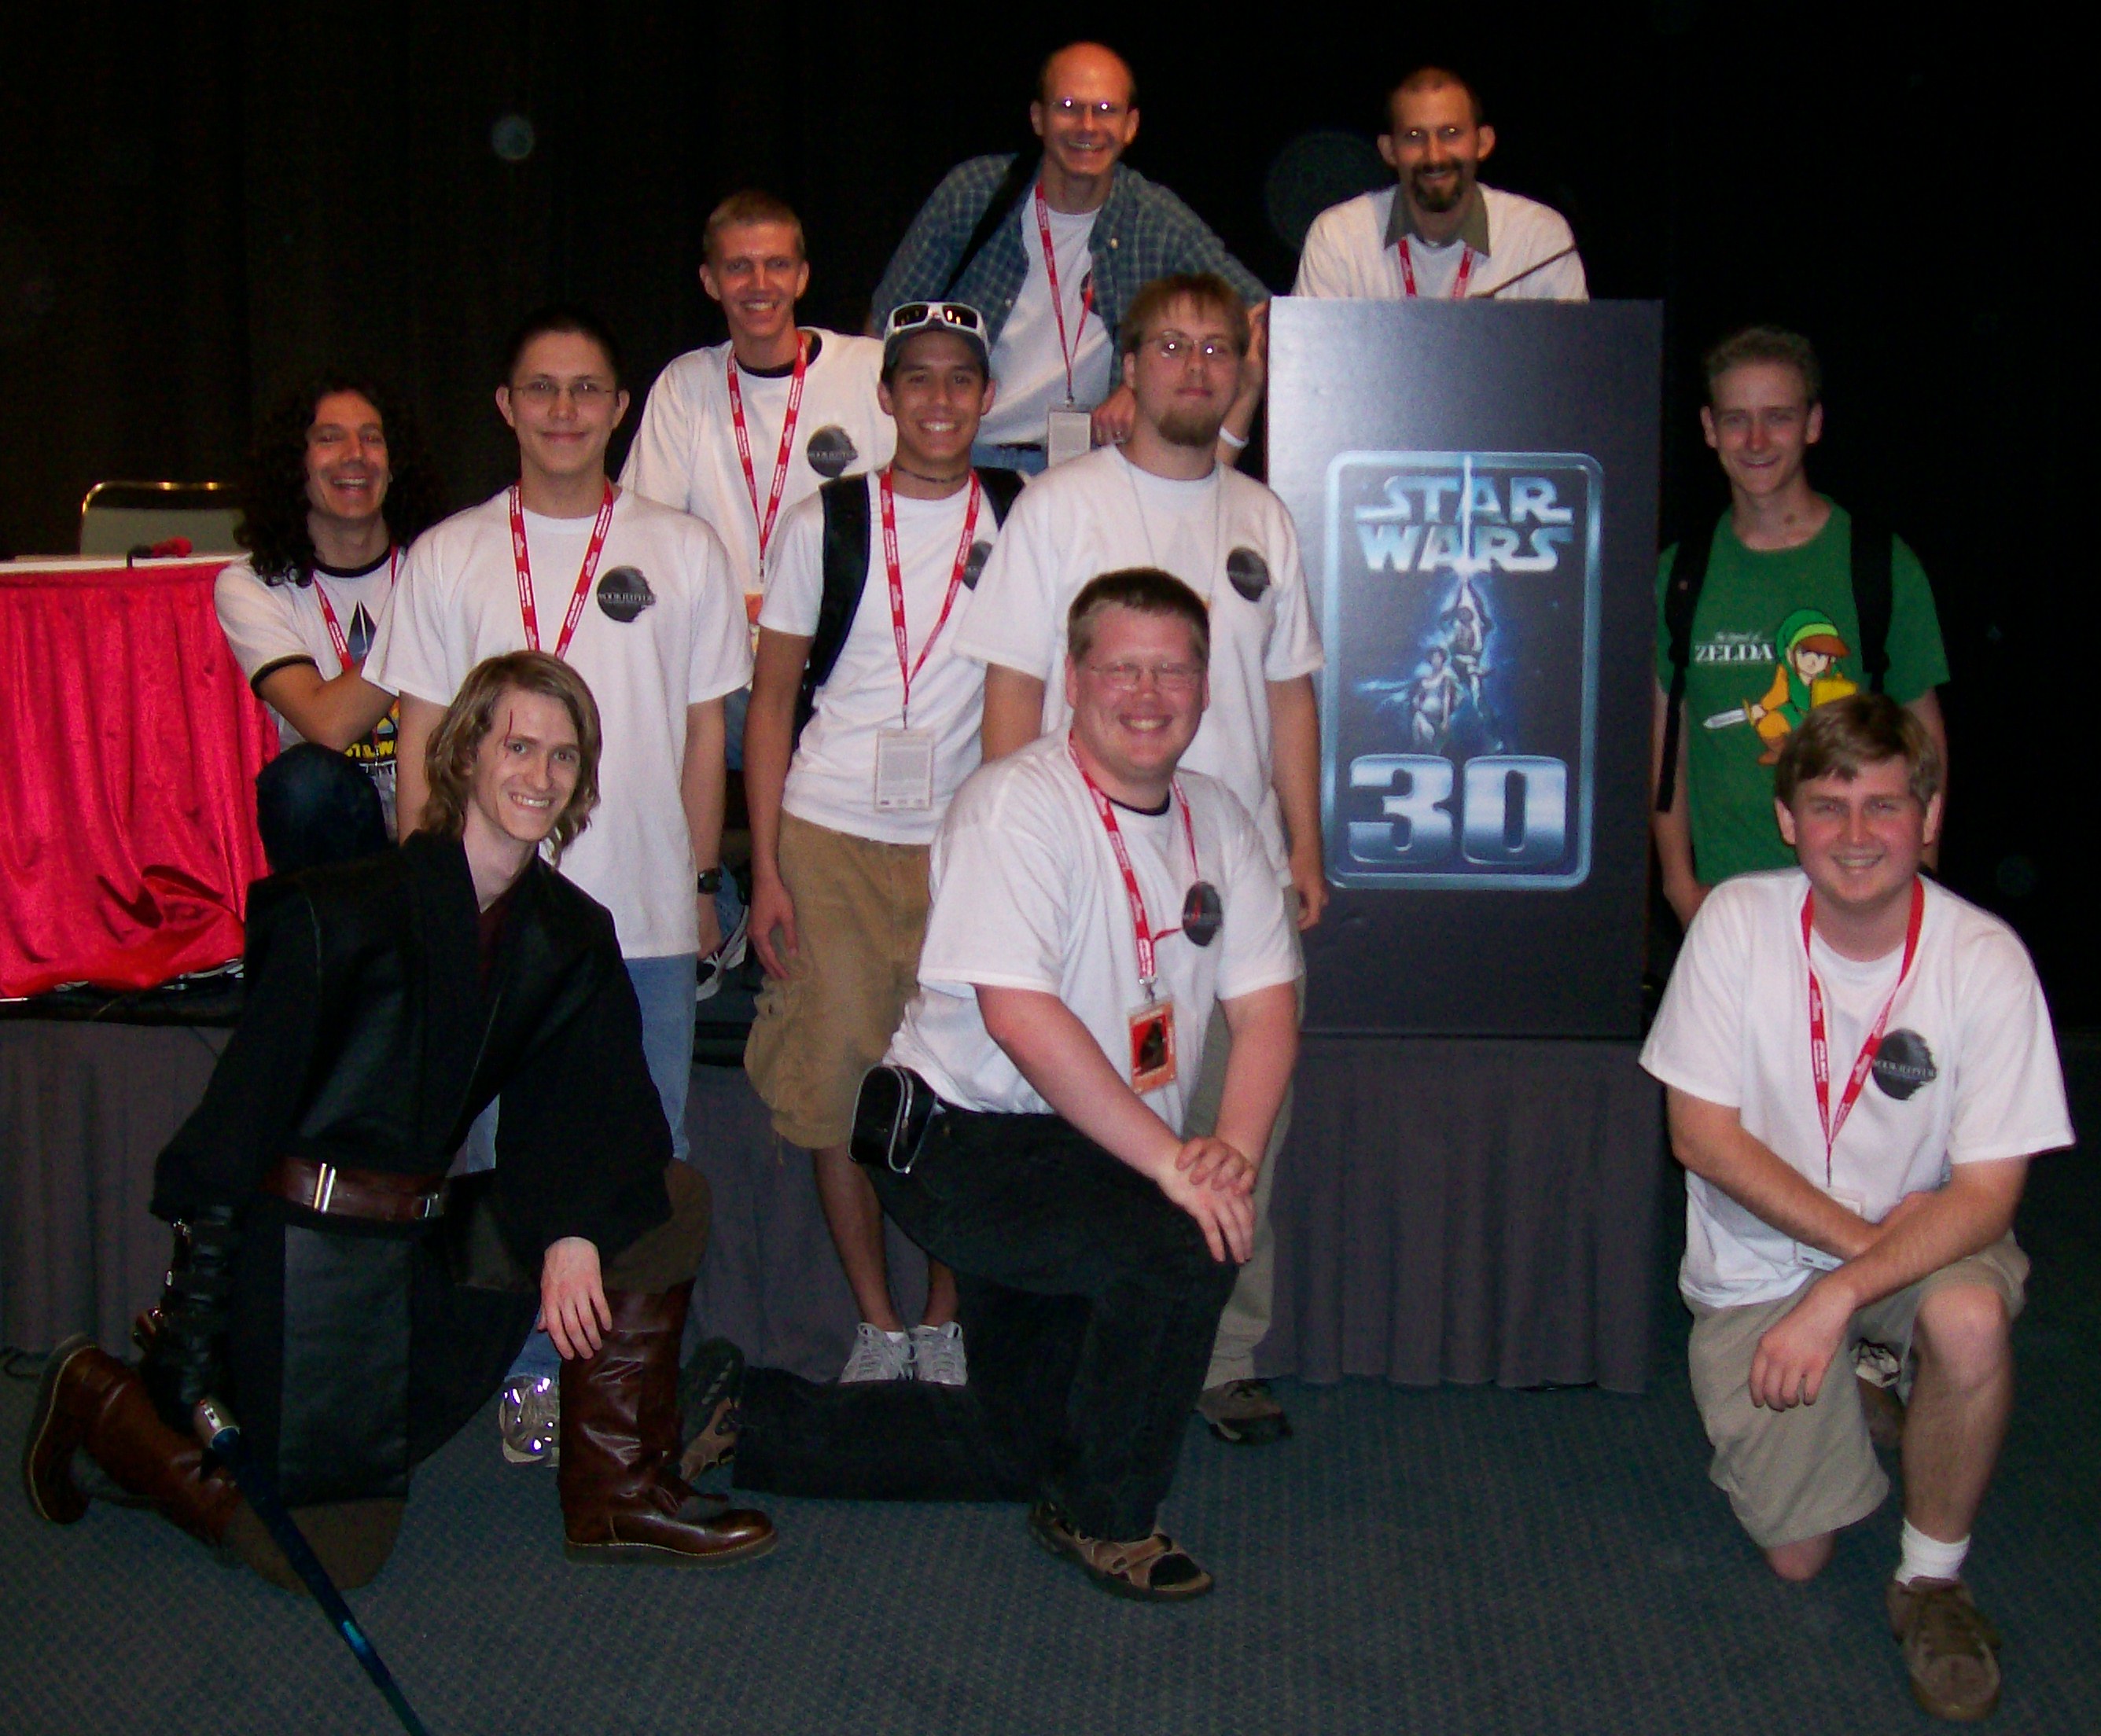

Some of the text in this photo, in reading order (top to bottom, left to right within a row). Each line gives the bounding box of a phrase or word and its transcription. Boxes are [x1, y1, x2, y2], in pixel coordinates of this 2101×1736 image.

[1354, 475, 1573, 524] STAR
[1354, 524, 1573, 572] WARS
[1694, 643, 1775, 662] ZELDA
[1347, 752, 1568, 864] 30
